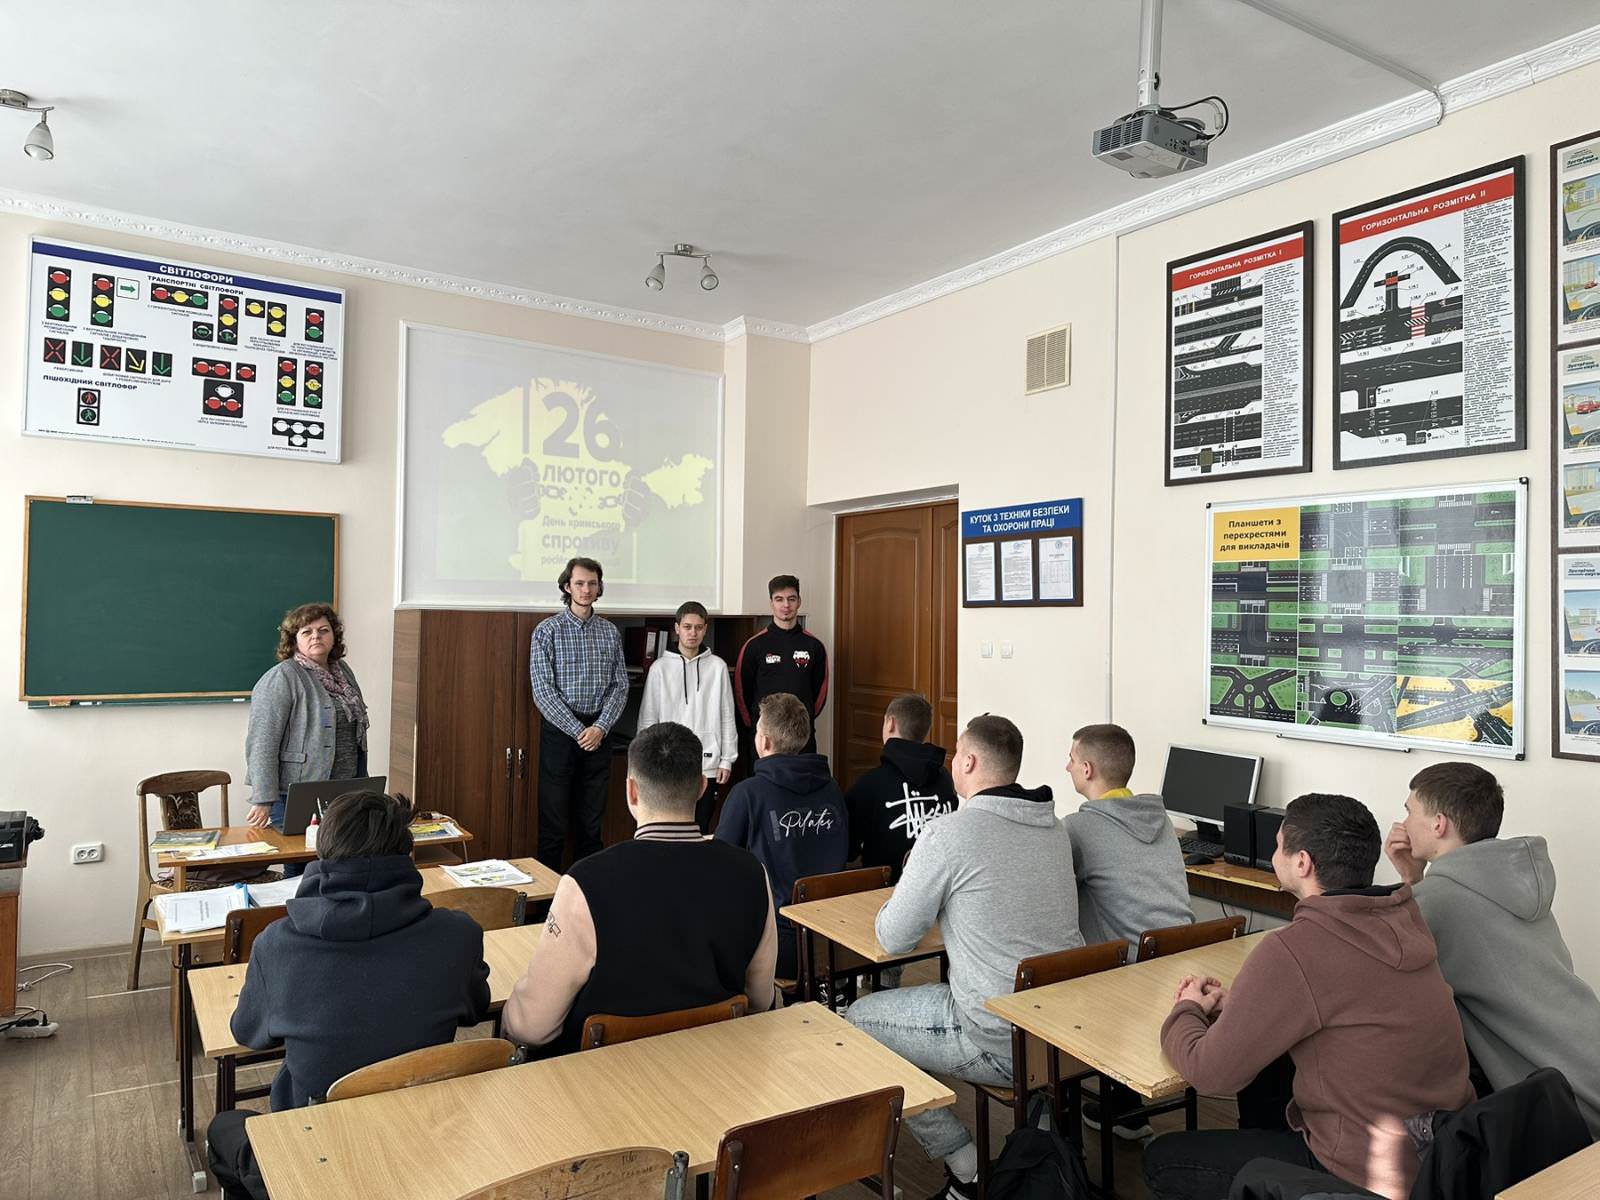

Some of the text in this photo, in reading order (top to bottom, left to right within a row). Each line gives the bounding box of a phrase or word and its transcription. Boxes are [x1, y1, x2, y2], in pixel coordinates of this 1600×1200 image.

[1360, 206, 1430, 233] ГОРИЗОНТАЛЬНА
[1432, 191, 1477, 211] РОЗМІТКА
[159, 265, 234, 285] СВІТЛОФОРИ
[1189, 260, 1242, 281] ГОРИЗОНТАЛЬНА
[1243, 251, 1277, 266] РОЗМІТКА
[147, 275, 244, 296] ТРАНСПОРТНІ СВІТЛОФОРИ
[43, 374, 94, 387] ПІШОХІДНИЙ
[95, 381, 138, 391] СВІТЛОФОР
[541, 391, 623, 462] 26
[543, 464, 621, 487] ЛЮТОГО
[542, 515, 566, 528] День
[969, 514, 992, 525] КУТОК
[999, 509, 1031, 520] ТЕХНІКИ
[1033, 505, 1070, 517] БЕЗПЕКИ
[1228, 519, 1274, 529] Планшети
[982, 518, 1055, 533] ТА ОХОРОНИ ПРАЦІ
[1223, 529, 1287, 541] перехрестями
[541, 533, 620, 556] спротиву
[1219, 540, 1290, 552] для викладачів
[779, 808, 834, 838] Pilates
